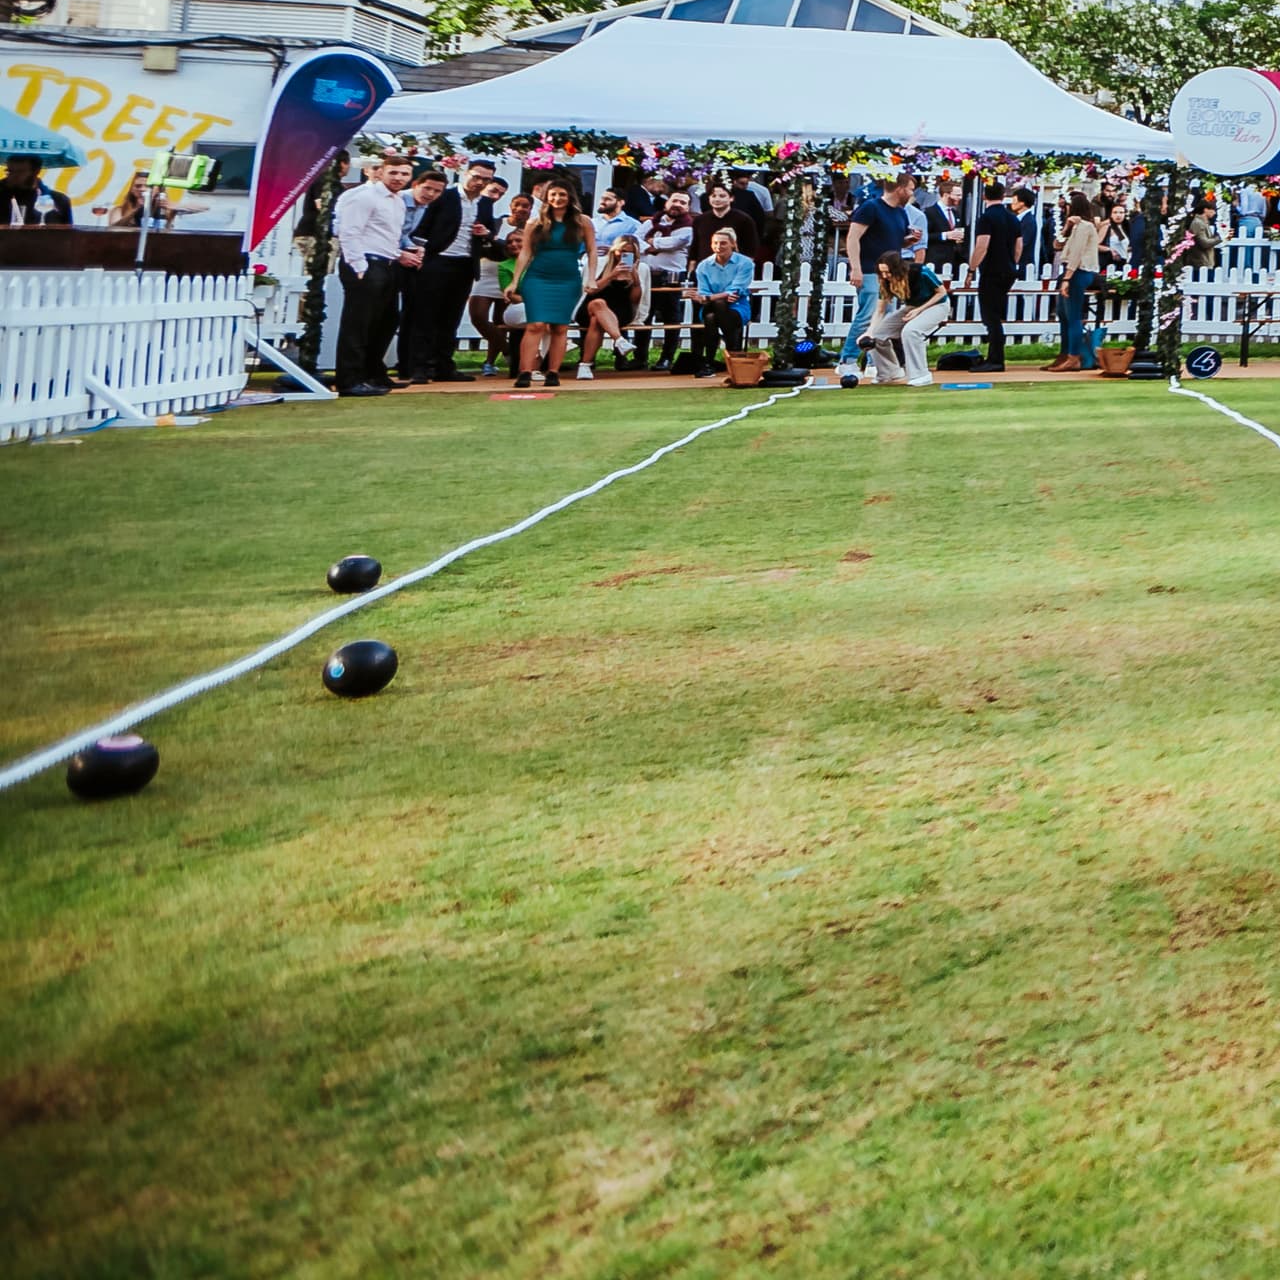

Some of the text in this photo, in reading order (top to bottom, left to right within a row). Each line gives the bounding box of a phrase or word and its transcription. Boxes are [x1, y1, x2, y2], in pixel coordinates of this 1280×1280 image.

[0, 63, 234, 152] TREET
[1187, 97, 1220, 109] THE
[1187, 109, 1262, 125] BOWLS
[1186, 123, 1240, 137] CLUB
[1192, 350, 1216, 372] 4
